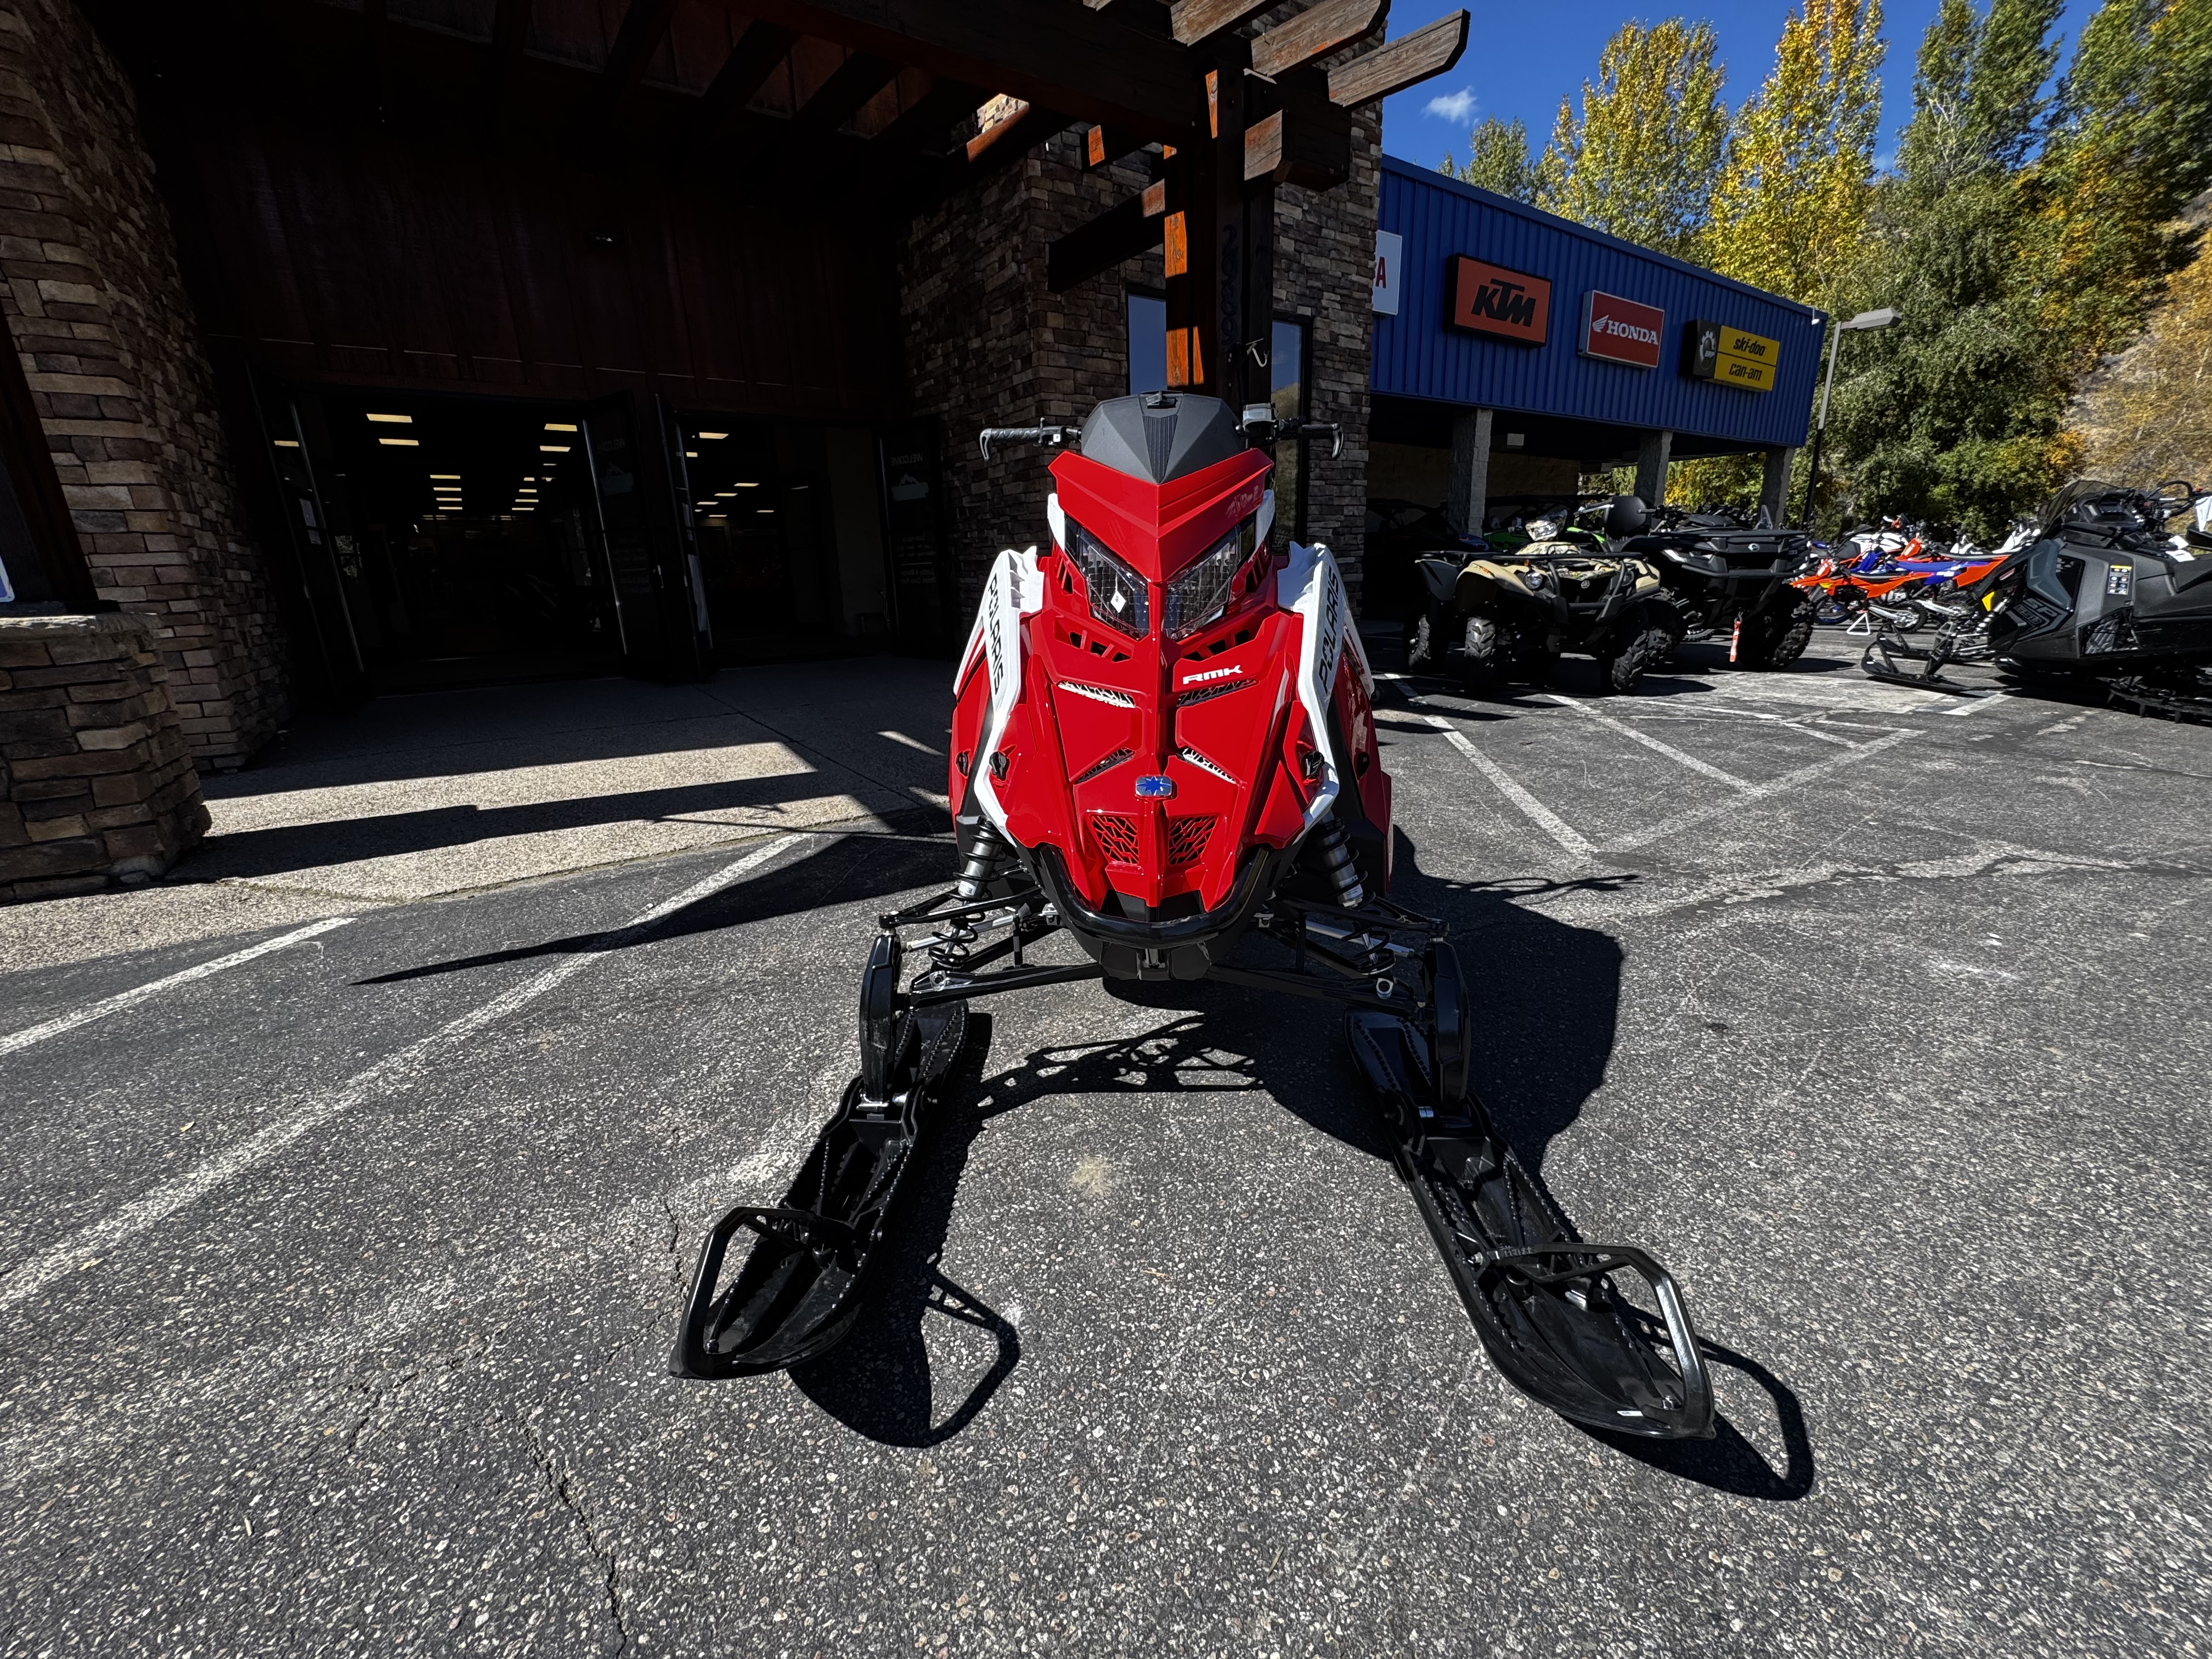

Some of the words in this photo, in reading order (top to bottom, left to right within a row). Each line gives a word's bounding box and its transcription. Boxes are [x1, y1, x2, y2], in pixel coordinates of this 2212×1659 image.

[1375, 256, 1386, 289] A
[1471, 278, 1536, 328] KTM
[1606, 320, 1658, 345] HONDA
[1733, 337, 1765, 357] ski-doo
[1729, 363, 1762, 381] can-am
[2022, 597, 2058, 618] SP
[988, 572, 1003, 696] POLARIS
[1319, 565, 1339, 695] POLARIS
[1182, 664, 1244, 685] RMK
